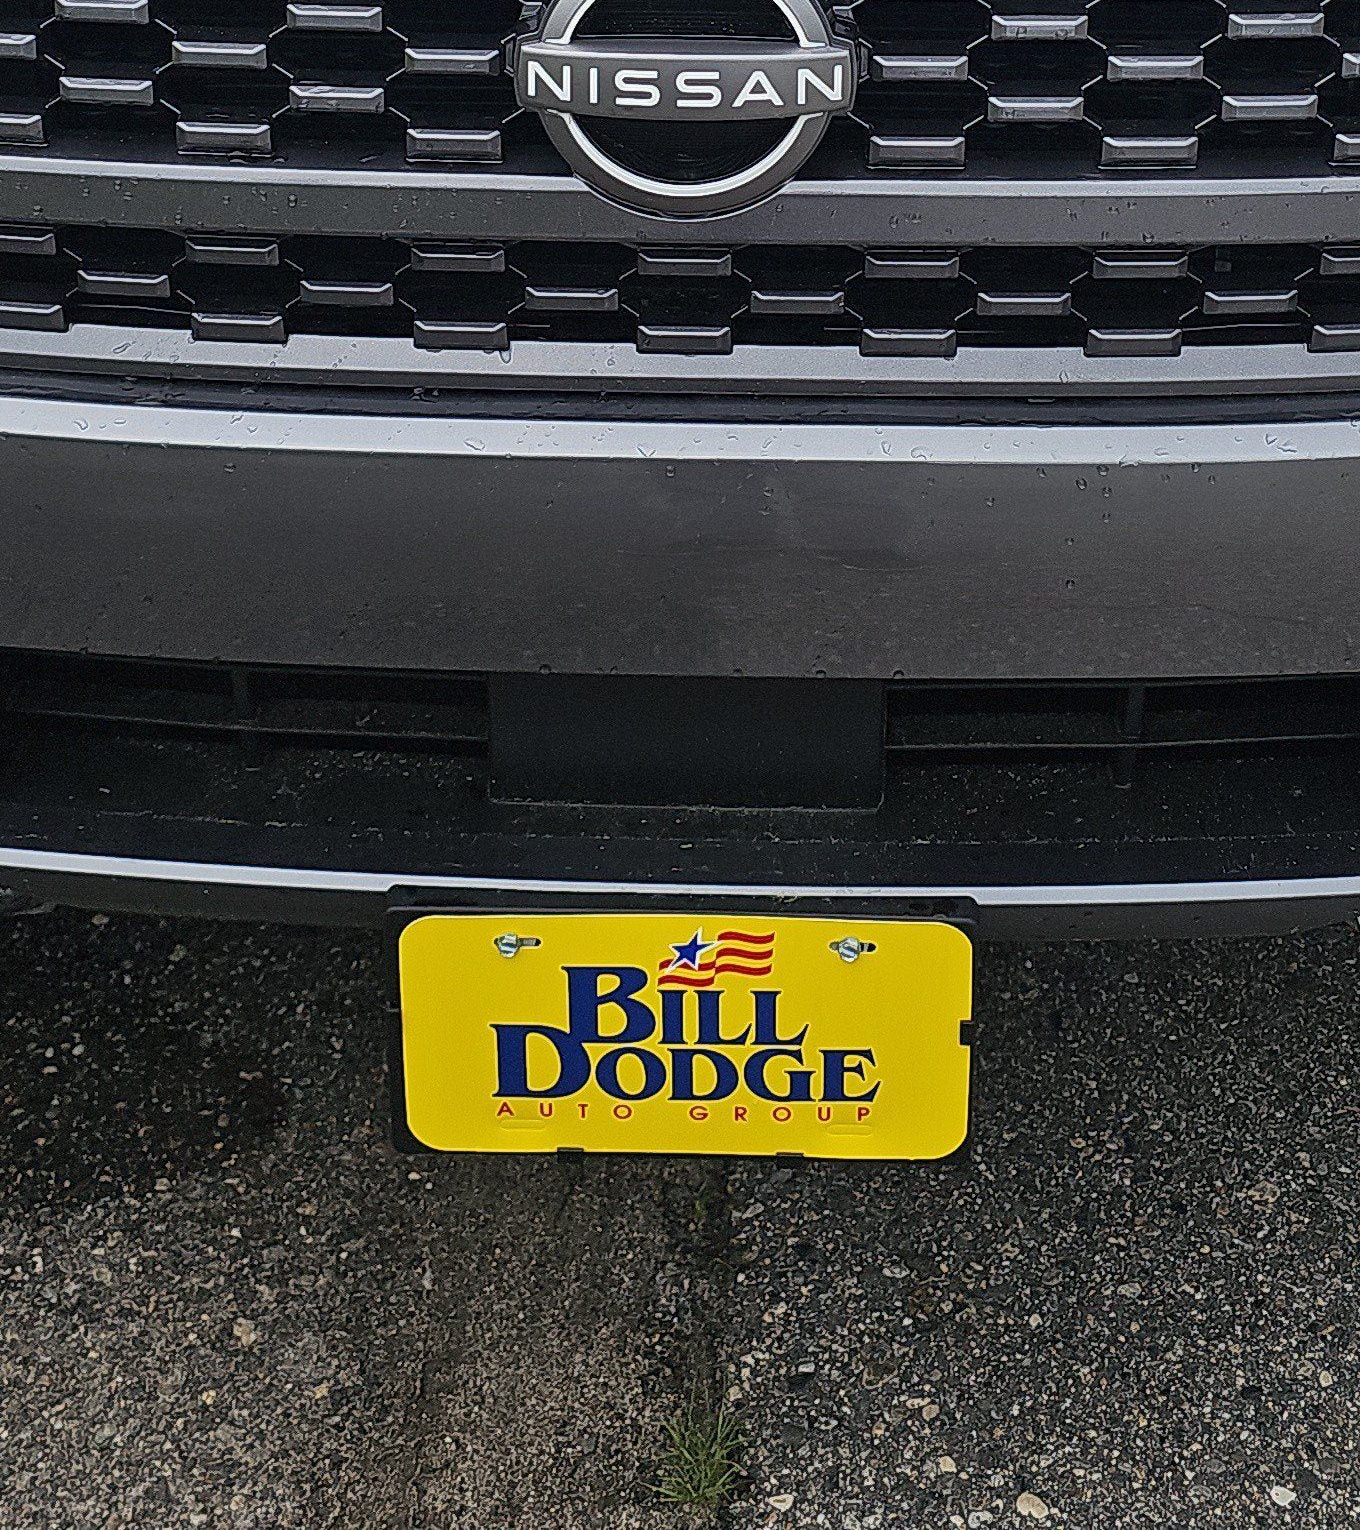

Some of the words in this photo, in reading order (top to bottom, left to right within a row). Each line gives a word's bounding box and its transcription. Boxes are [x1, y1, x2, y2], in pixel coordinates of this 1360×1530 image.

[527, 61, 843, 107] NISSAN
[561, 965, 809, 1046] BILL
[489, 1023, 882, 1103] DODGE
[497, 1101, 633, 1119] AUTO
[689, 1104, 872, 1122] GROUP
